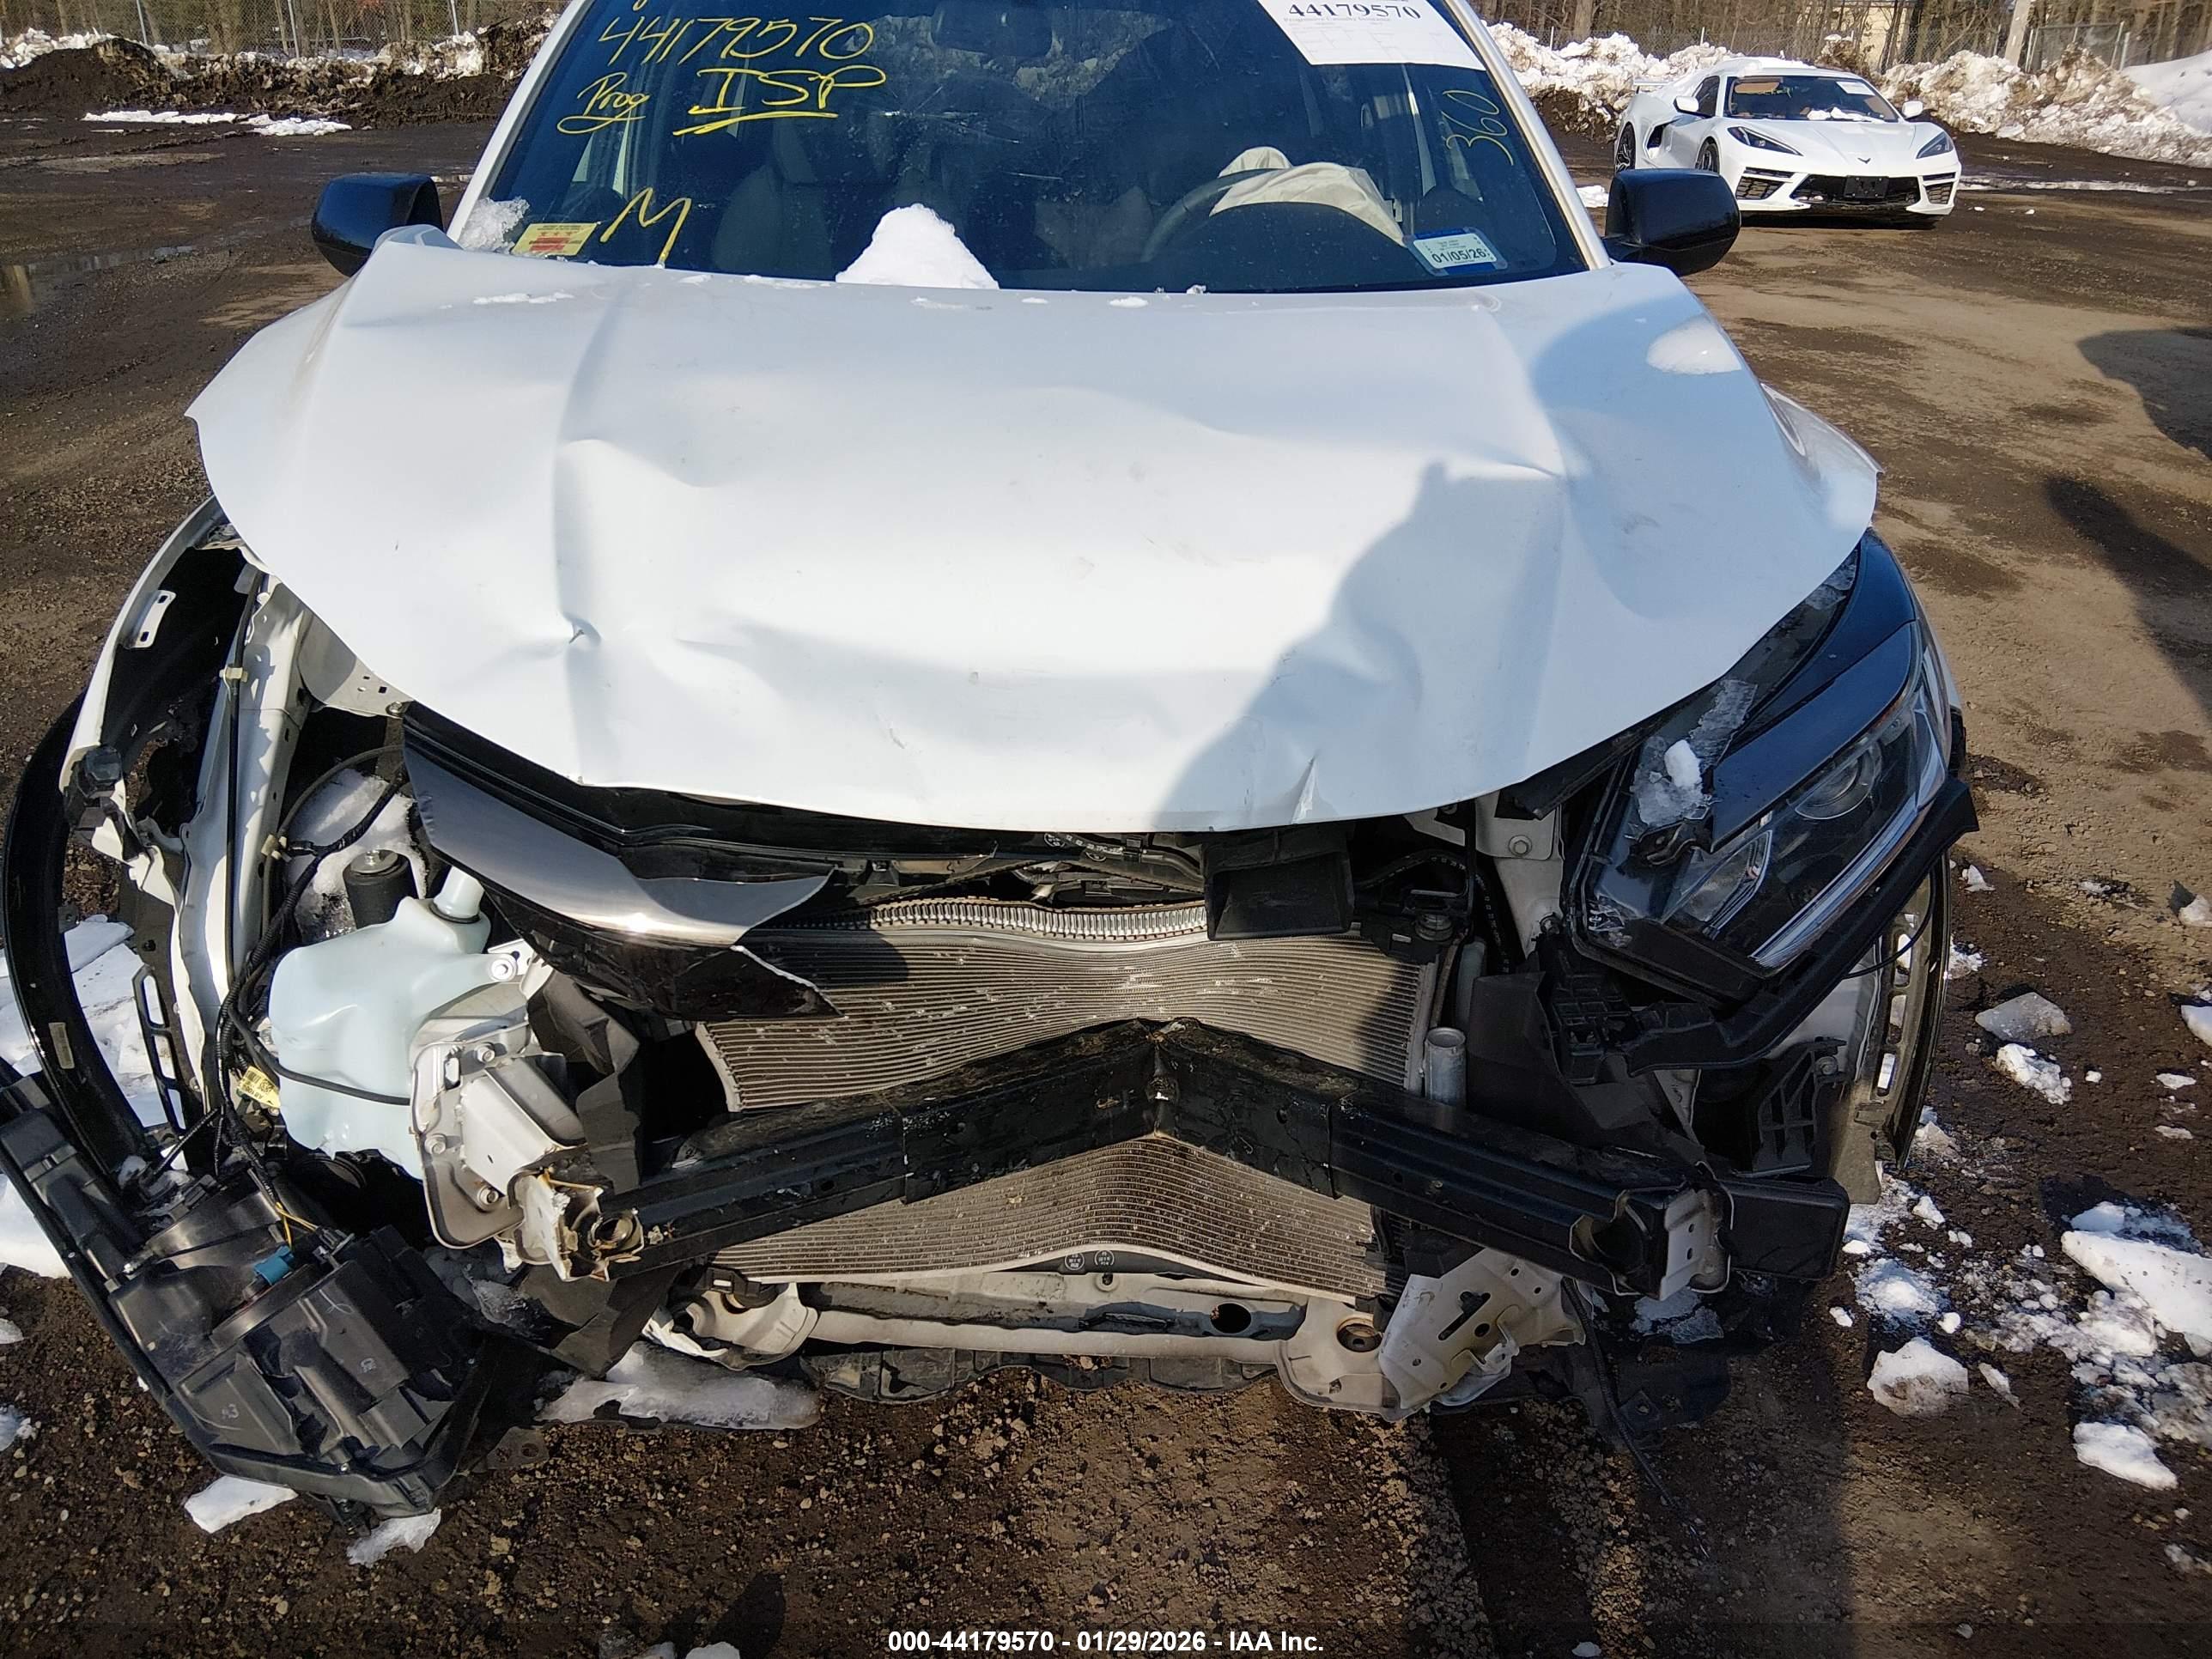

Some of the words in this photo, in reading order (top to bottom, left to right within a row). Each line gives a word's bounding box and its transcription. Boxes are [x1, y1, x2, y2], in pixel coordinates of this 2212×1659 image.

[598, 15, 874, 66] 44179570
[1289, 3, 1422, 19] 44179570
[556, 71, 651, 134] Prog
[688, 65, 886, 115] ISP
[1441, 89, 1514, 167] 360
[601, 187, 692, 267] M
[1431, 248, 1486, 263] 01/05/26
